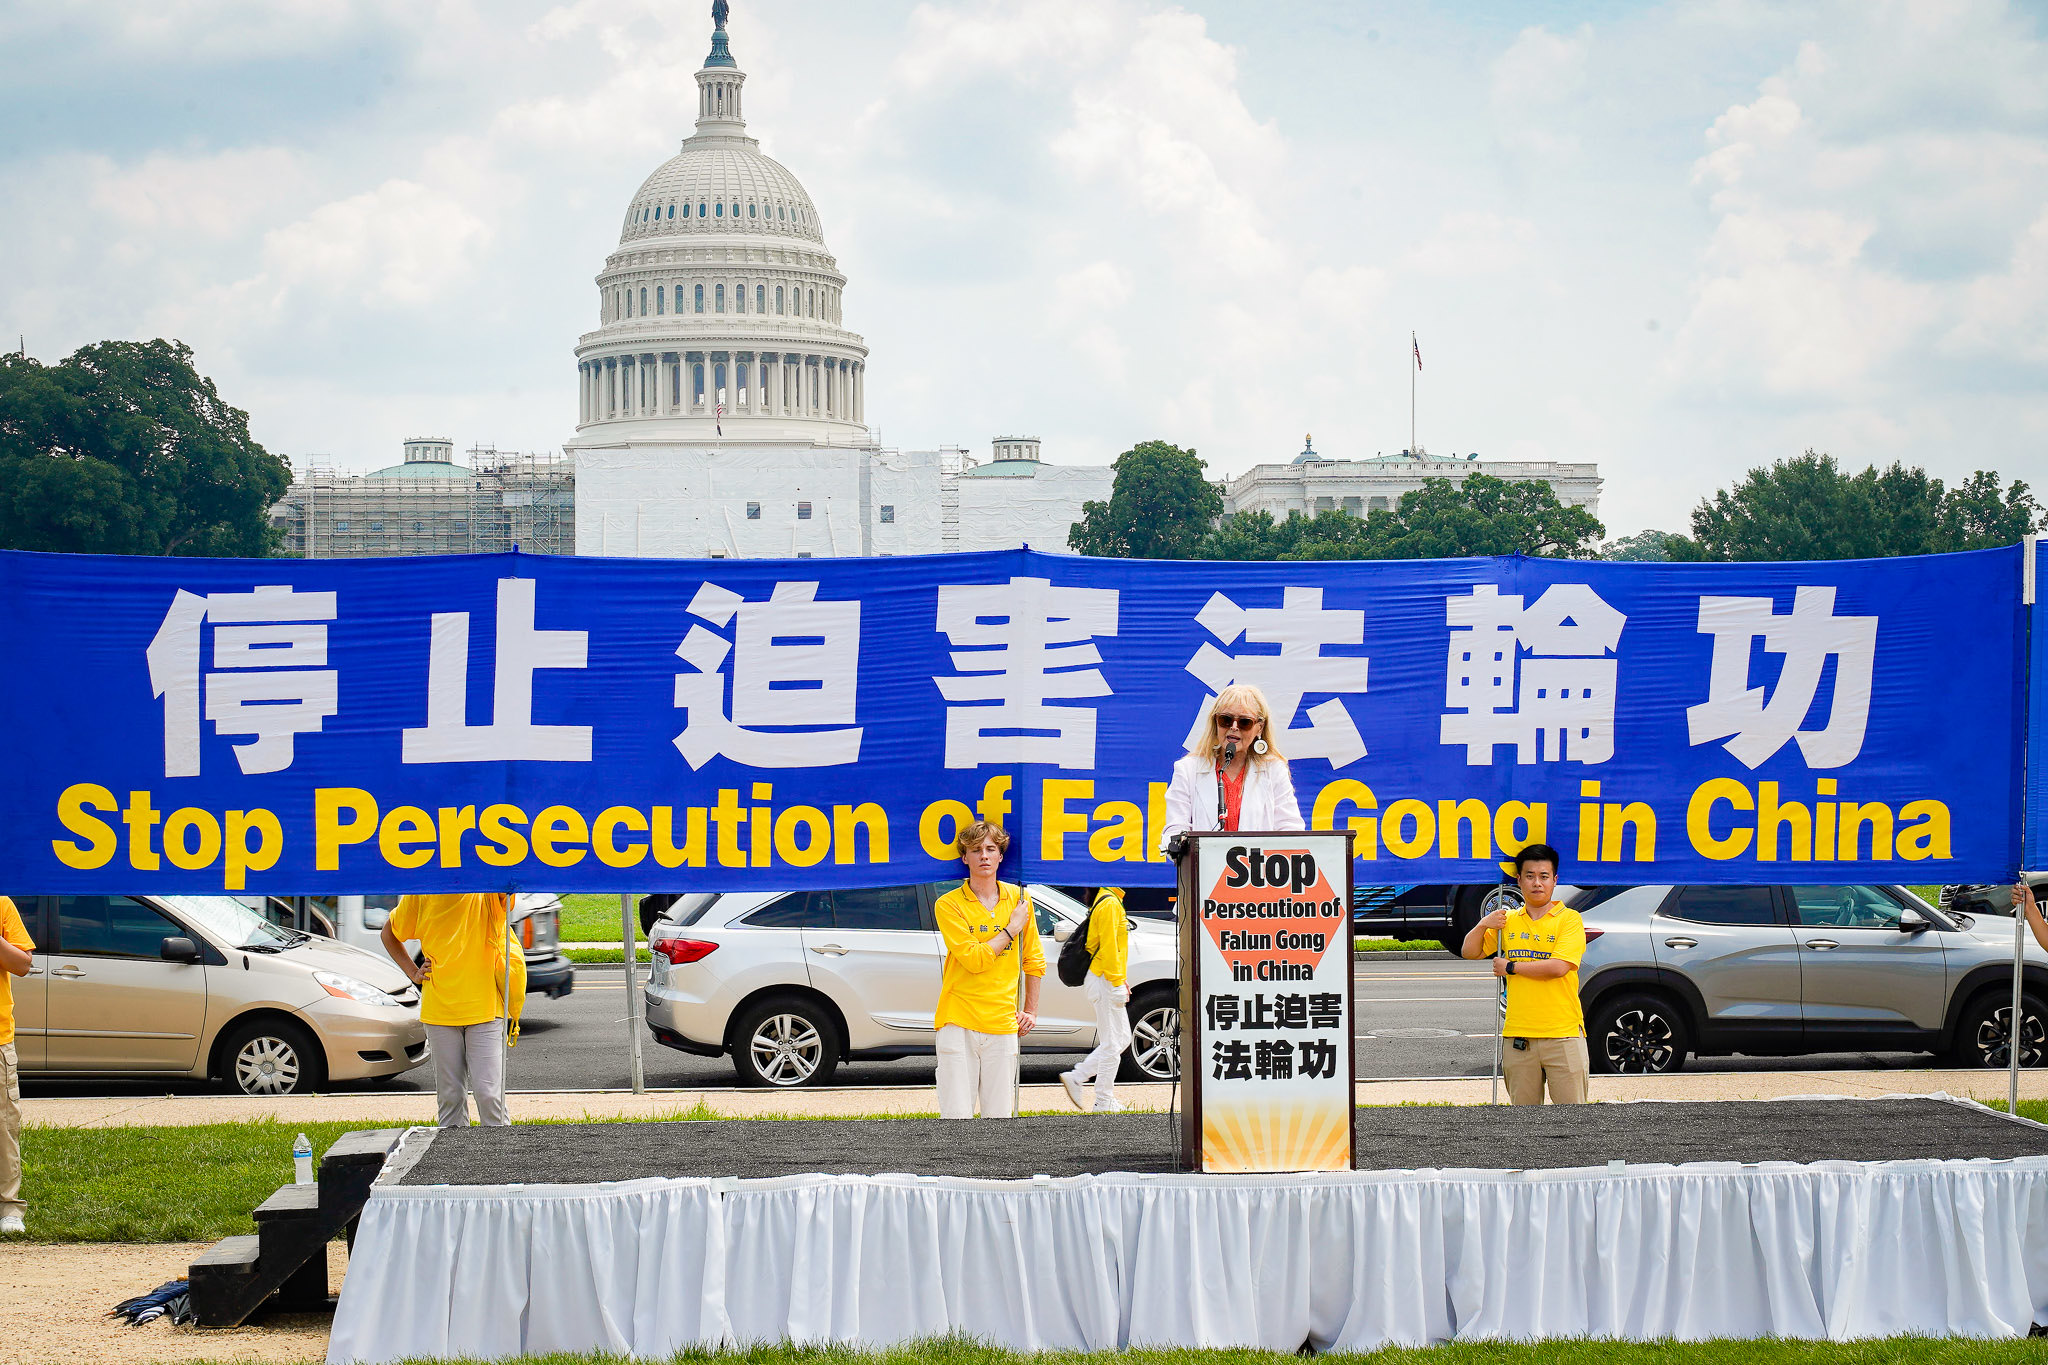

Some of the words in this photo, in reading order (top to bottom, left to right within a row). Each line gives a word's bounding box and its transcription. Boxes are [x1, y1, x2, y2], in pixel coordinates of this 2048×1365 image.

[147, 577, 1879, 777] 停止迫害法輪功
[52, 784, 284, 890] Stop
[315, 783, 890, 871] Persecution
[919, 776, 1012, 861] of
[1041, 779, 1168, 863] Fal
[1312, 779, 1548, 877] Gong
[1578, 780, 1657, 862] in
[1687, 778, 1953, 862] China
[1226, 846, 1316, 894] Stop
[1204, 898, 1317, 919] Persecution
[1321, 897, 1341, 918] of
[1220, 930, 1271, 950] Falun
[1276, 931, 1325, 952] Gong
[1233, 961, 1253, 981] in
[1258, 960, 1314, 981] China
[1205, 993, 1342, 1031] 停止迫害
[1212, 1038, 1337, 1081] 法輪功
